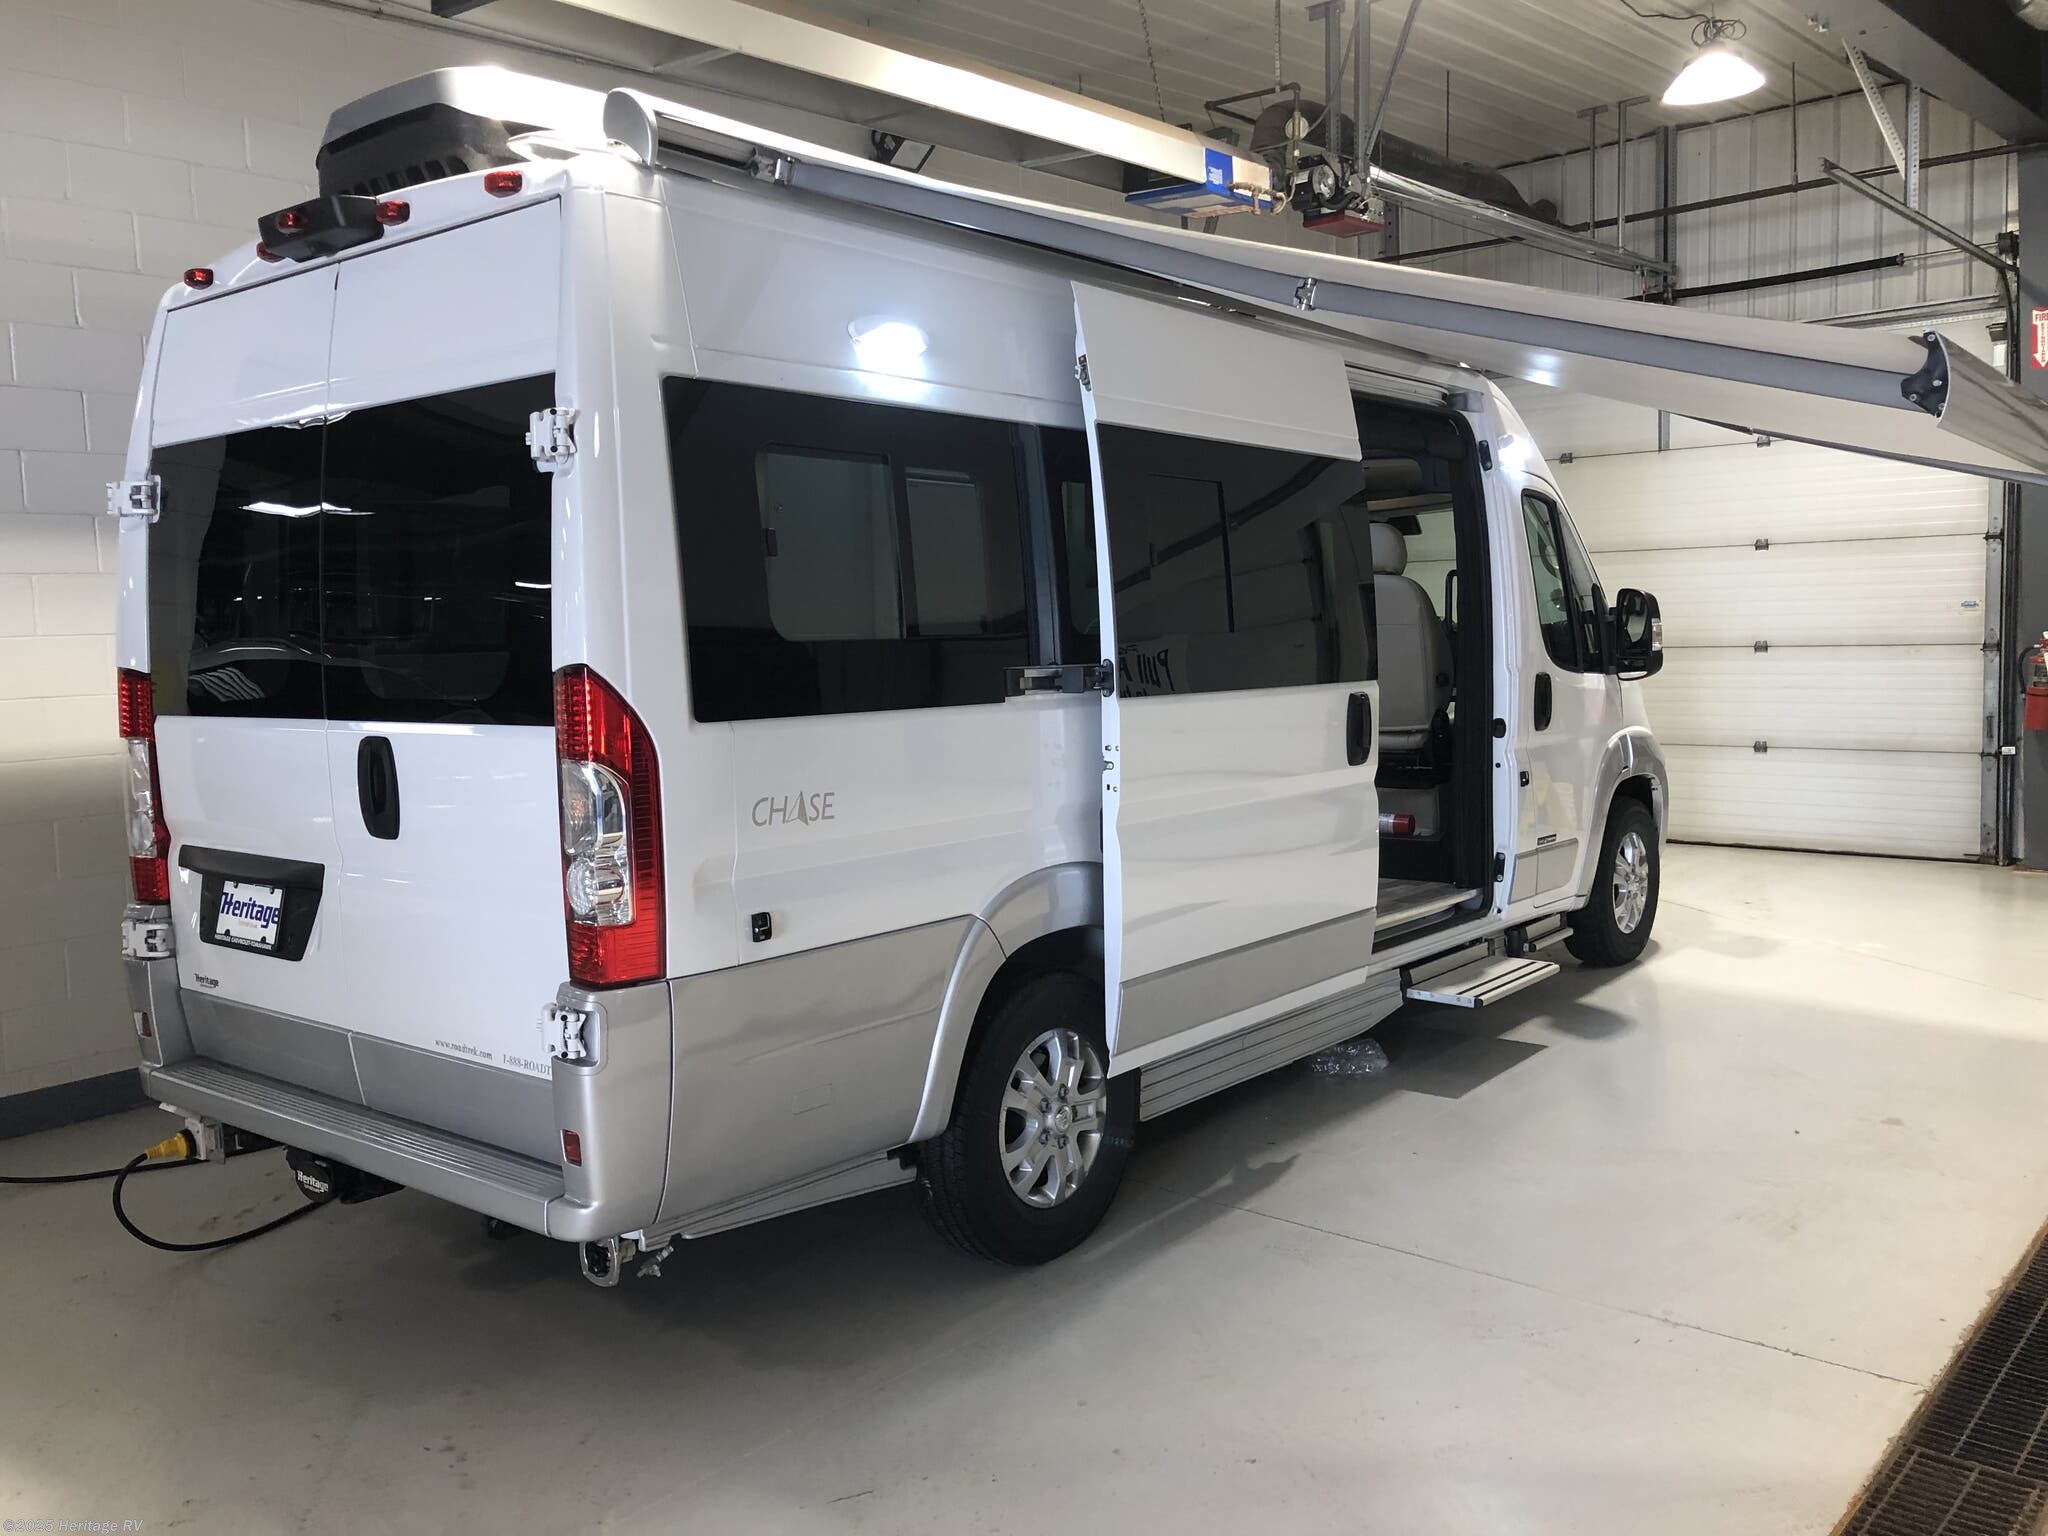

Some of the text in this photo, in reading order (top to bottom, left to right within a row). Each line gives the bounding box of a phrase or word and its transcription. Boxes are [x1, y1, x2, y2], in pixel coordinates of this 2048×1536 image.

[2035, 313, 2048, 321] FIR
[752, 790, 835, 827] CHASE
[220, 891, 281, 929] Heritage
[434, 1039, 493, 1061] www.roadtrek.com
